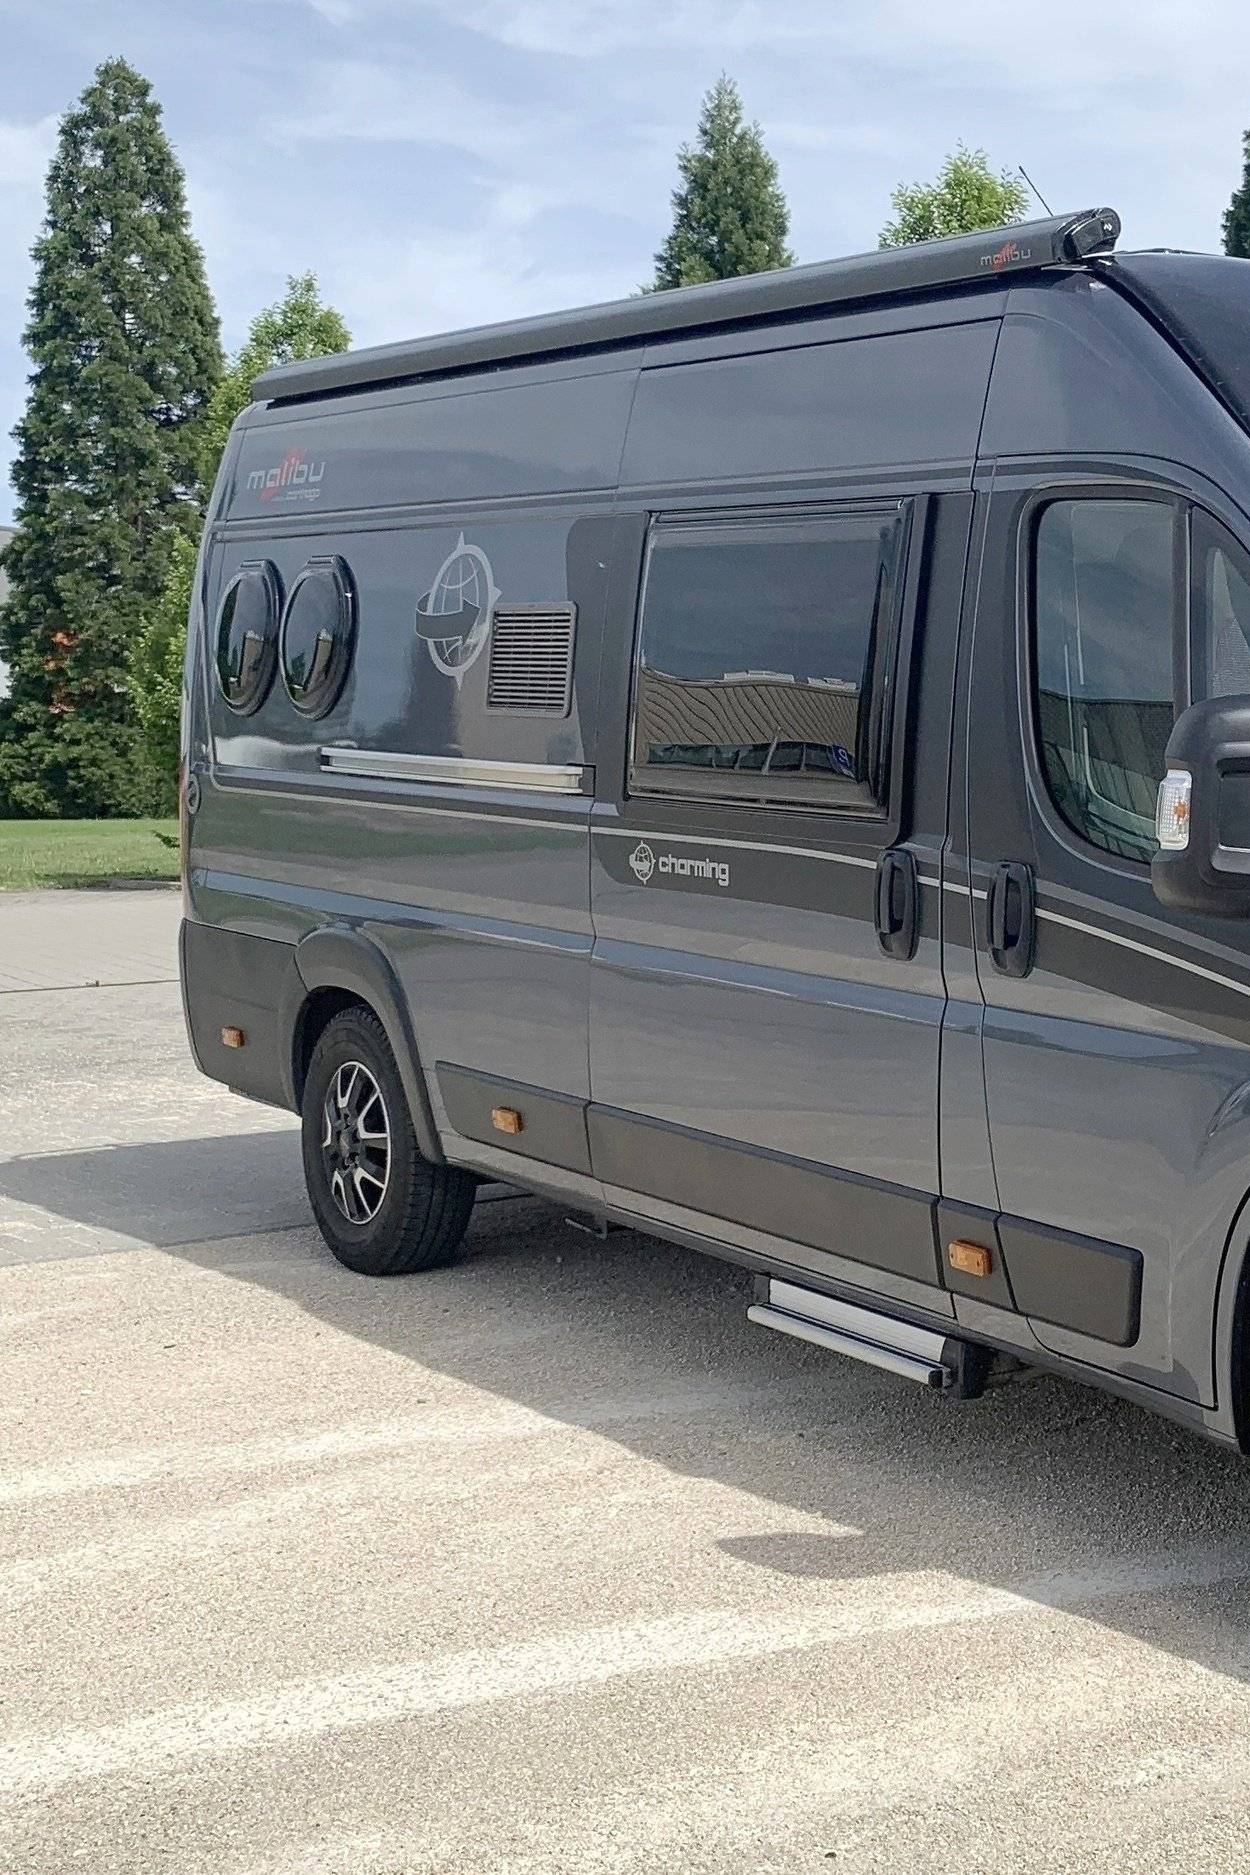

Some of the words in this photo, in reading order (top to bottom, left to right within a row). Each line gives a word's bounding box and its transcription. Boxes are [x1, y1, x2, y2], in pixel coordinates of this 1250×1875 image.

[980, 246, 1031, 266] malibu
[247, 457, 326, 489] malibu
[659, 853, 729, 886] charming
